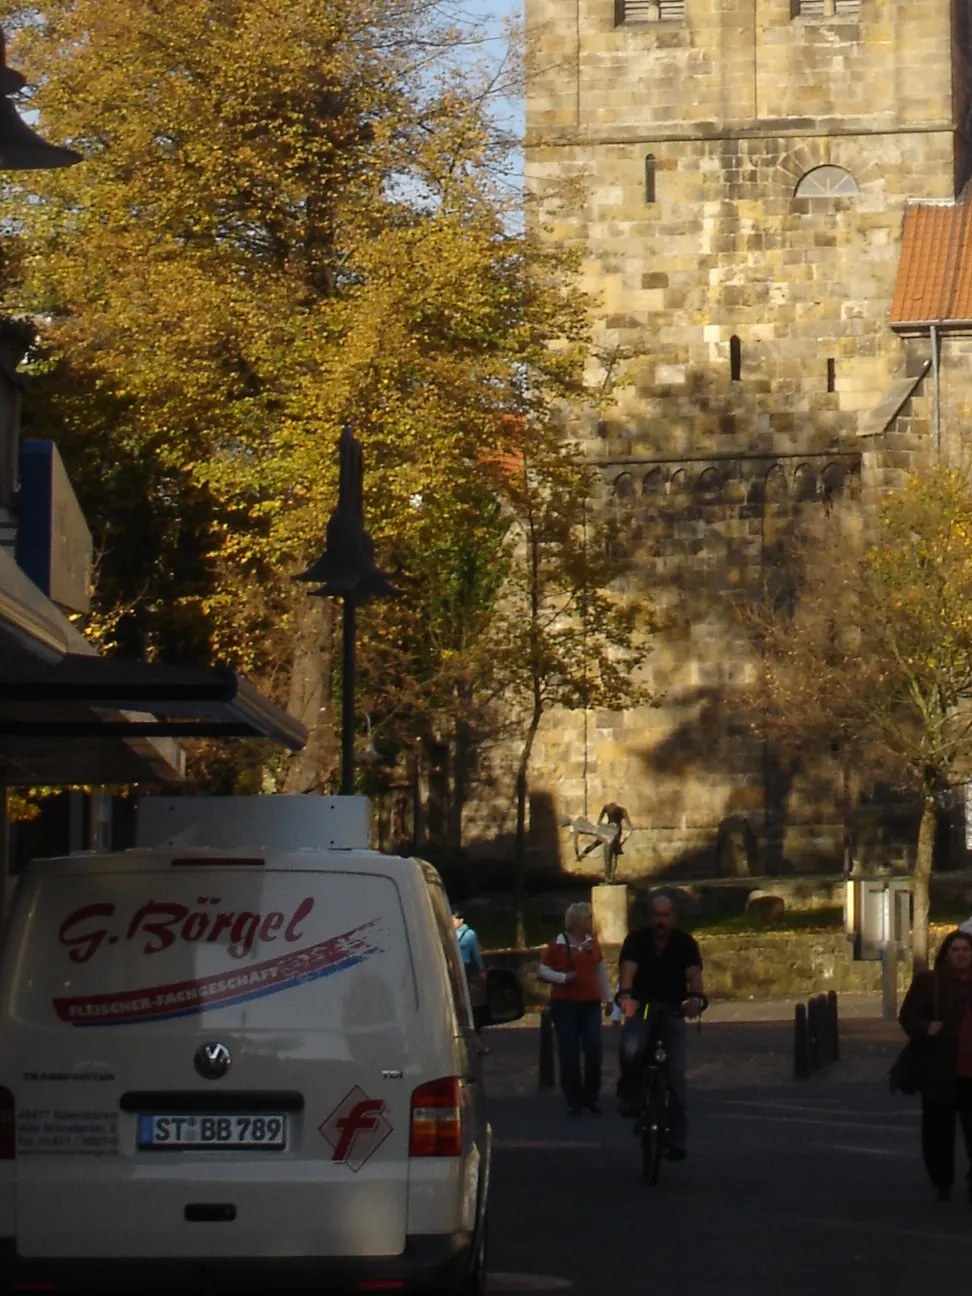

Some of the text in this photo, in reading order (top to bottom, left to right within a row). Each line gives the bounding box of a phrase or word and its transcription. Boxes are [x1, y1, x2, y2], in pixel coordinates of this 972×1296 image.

[155, 1116, 282, 1142] ST BB 789
